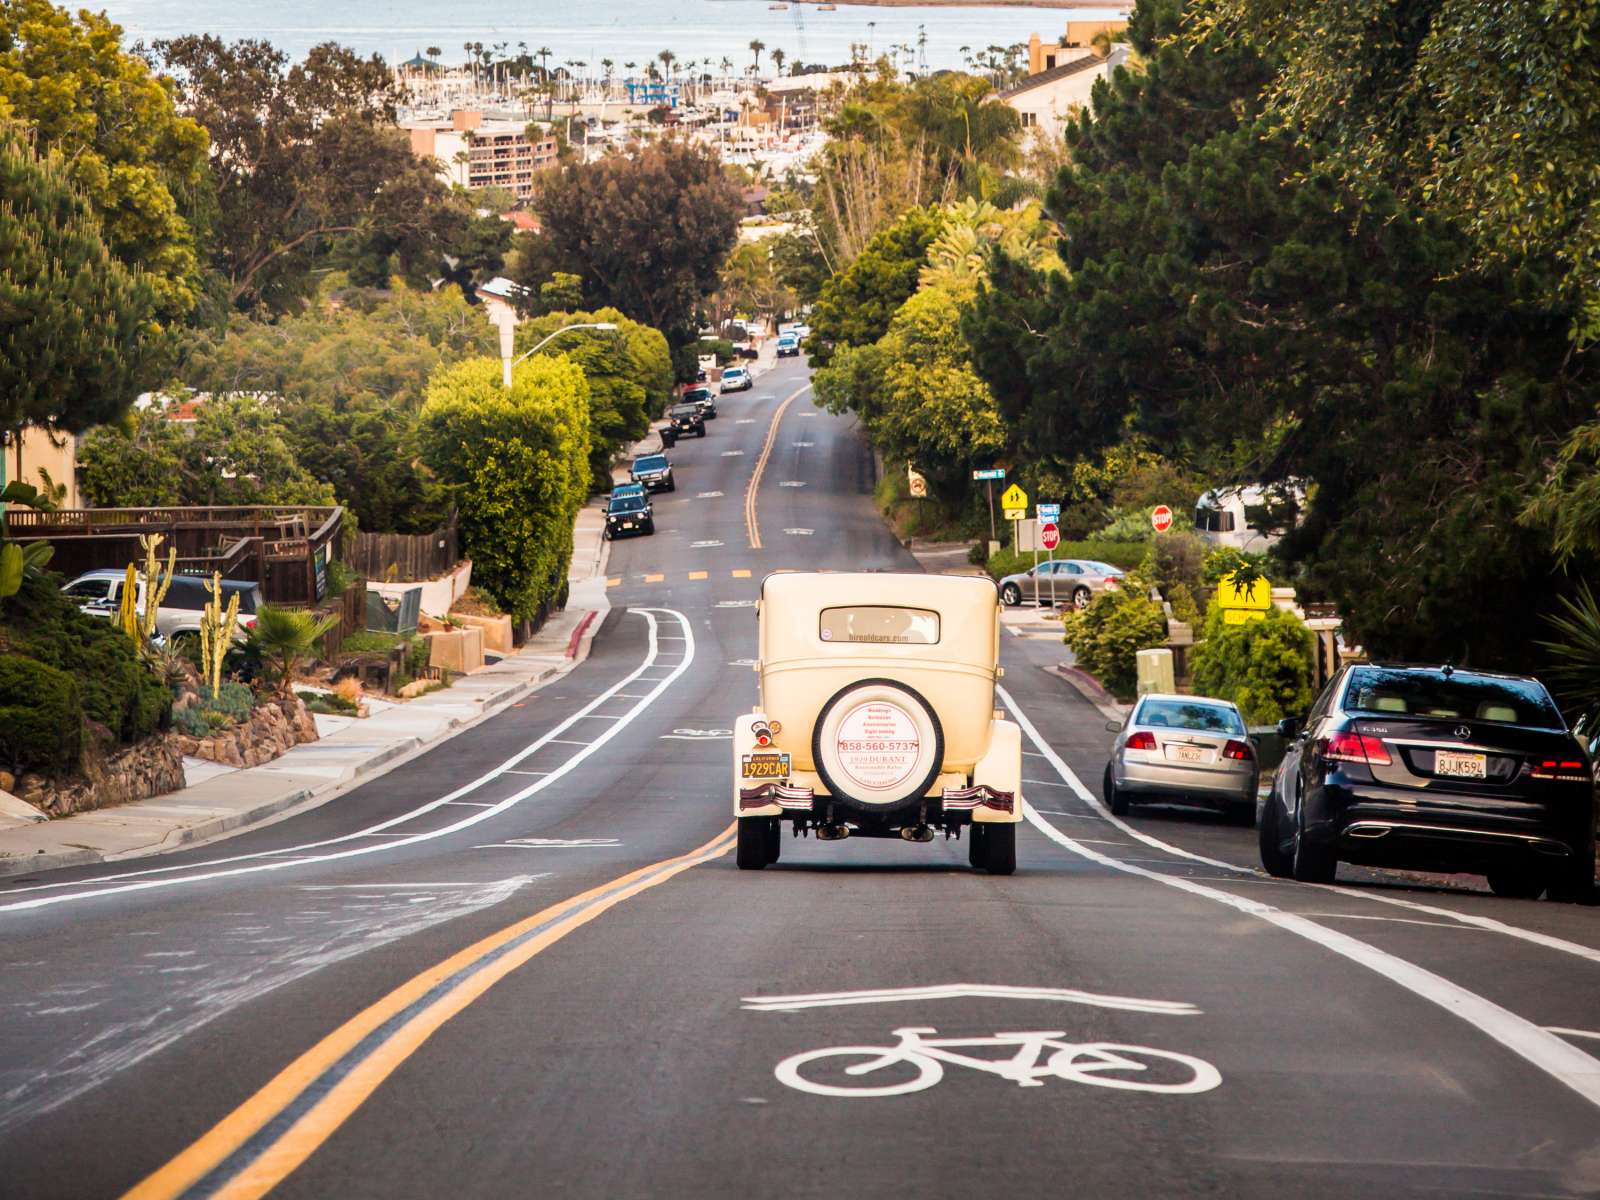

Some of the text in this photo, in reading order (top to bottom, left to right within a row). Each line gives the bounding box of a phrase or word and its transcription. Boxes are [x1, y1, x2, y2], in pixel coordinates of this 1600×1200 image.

[1152, 512, 1171, 524] STOP
[1043, 530, 1057, 542] STOP
[842, 742, 914, 751] 858-560-5737
[743, 762, 788, 776] 1929CAR
